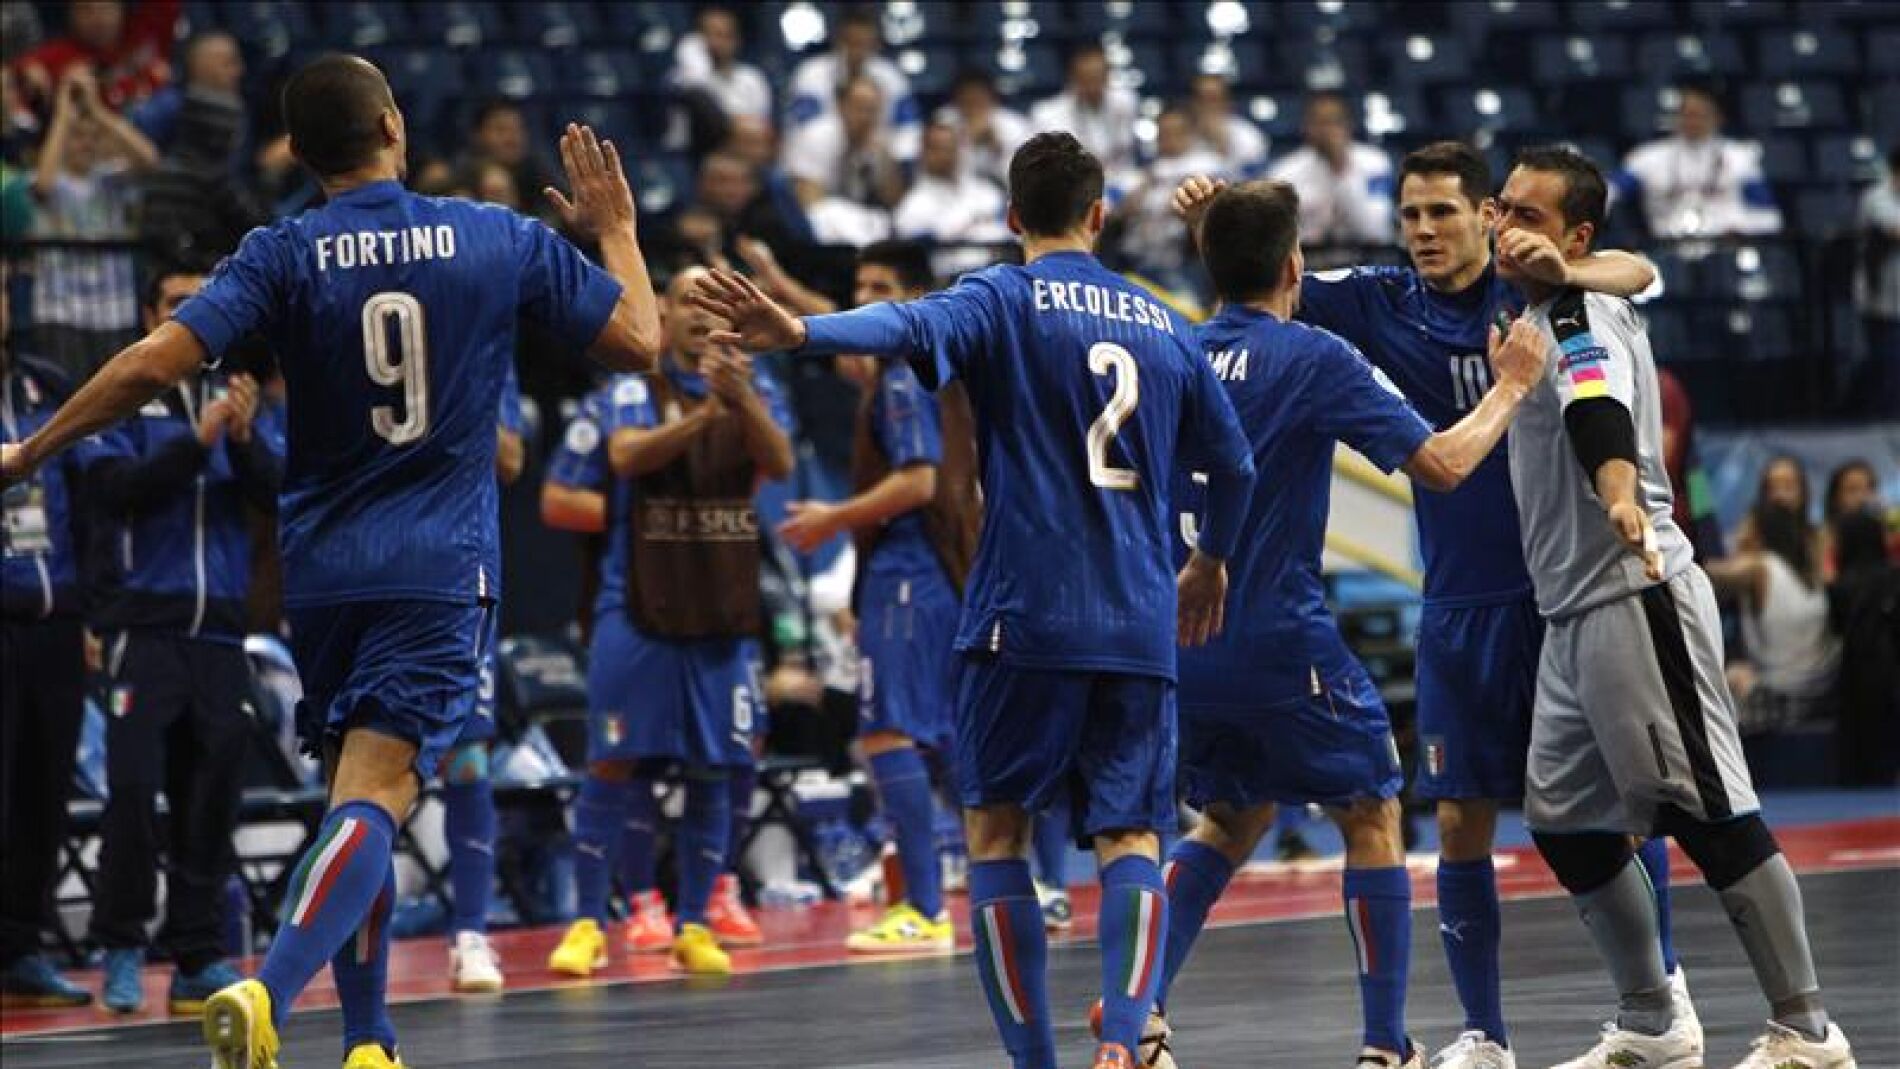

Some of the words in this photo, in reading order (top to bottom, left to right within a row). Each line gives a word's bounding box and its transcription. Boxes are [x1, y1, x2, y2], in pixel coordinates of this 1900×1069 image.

[316, 225, 455, 271] FORTINO
[1033, 279, 1174, 334] ERCOLESSI
[363, 292, 428, 444] 9
[1450, 355, 1487, 410] 10
[1088, 341, 1139, 489] 2
[733, 685, 753, 730] 6
